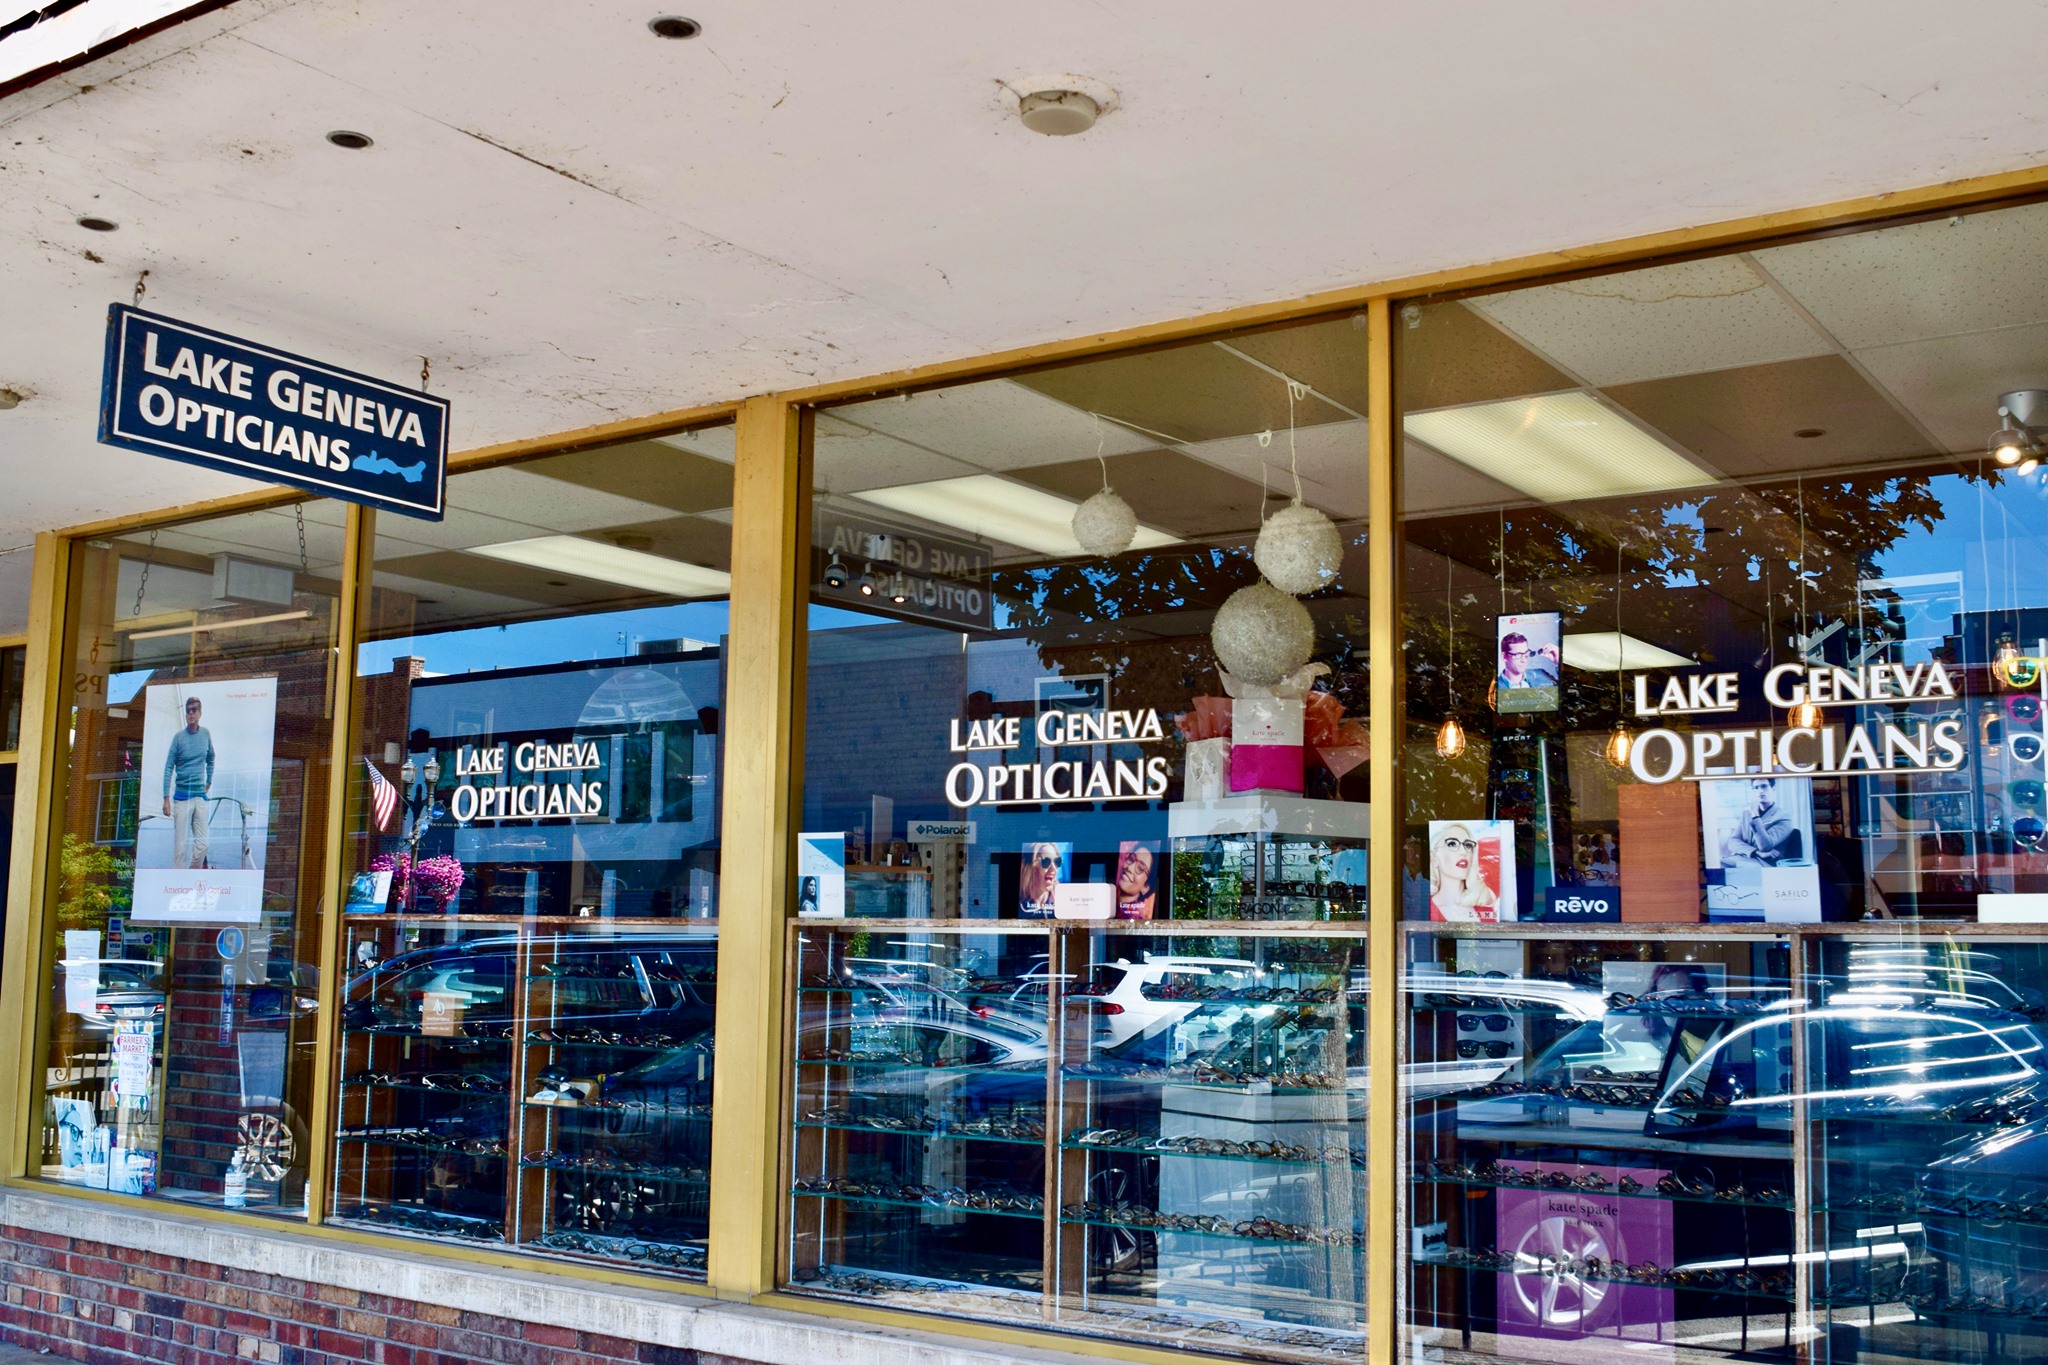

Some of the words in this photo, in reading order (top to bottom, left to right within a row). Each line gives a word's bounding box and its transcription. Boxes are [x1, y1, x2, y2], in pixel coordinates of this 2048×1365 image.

[143, 331, 253, 400] LAKE
[267, 369, 426, 447] GENEVA
[139, 385, 350, 472] OPTICIANS
[1634, 673, 1738, 716] LAKE
[1763, 659, 1956, 709] GENEVA
[950, 717, 1020, 752] LAKE
[1036, 707, 1164, 746] GENEVA
[456, 748, 504, 776] LAKE
[515, 742, 600, 772] GENEVA
[1629, 720, 1964, 784] OPTICIANS
[945, 755, 1169, 809] OPTICIANS
[451, 781, 602, 822] OPTICIANS
[926, 824, 970, 835] Polaroid
[163, 886, 194, 895] American
[1774, 889, 1809, 898] SAFILO
[120, 1035, 149, 1045] FARMER'S
[122, 1044, 145, 1053] MARKET
[1548, 1199, 1576, 1212] kate
[1580, 1203, 1619, 1217] spade
